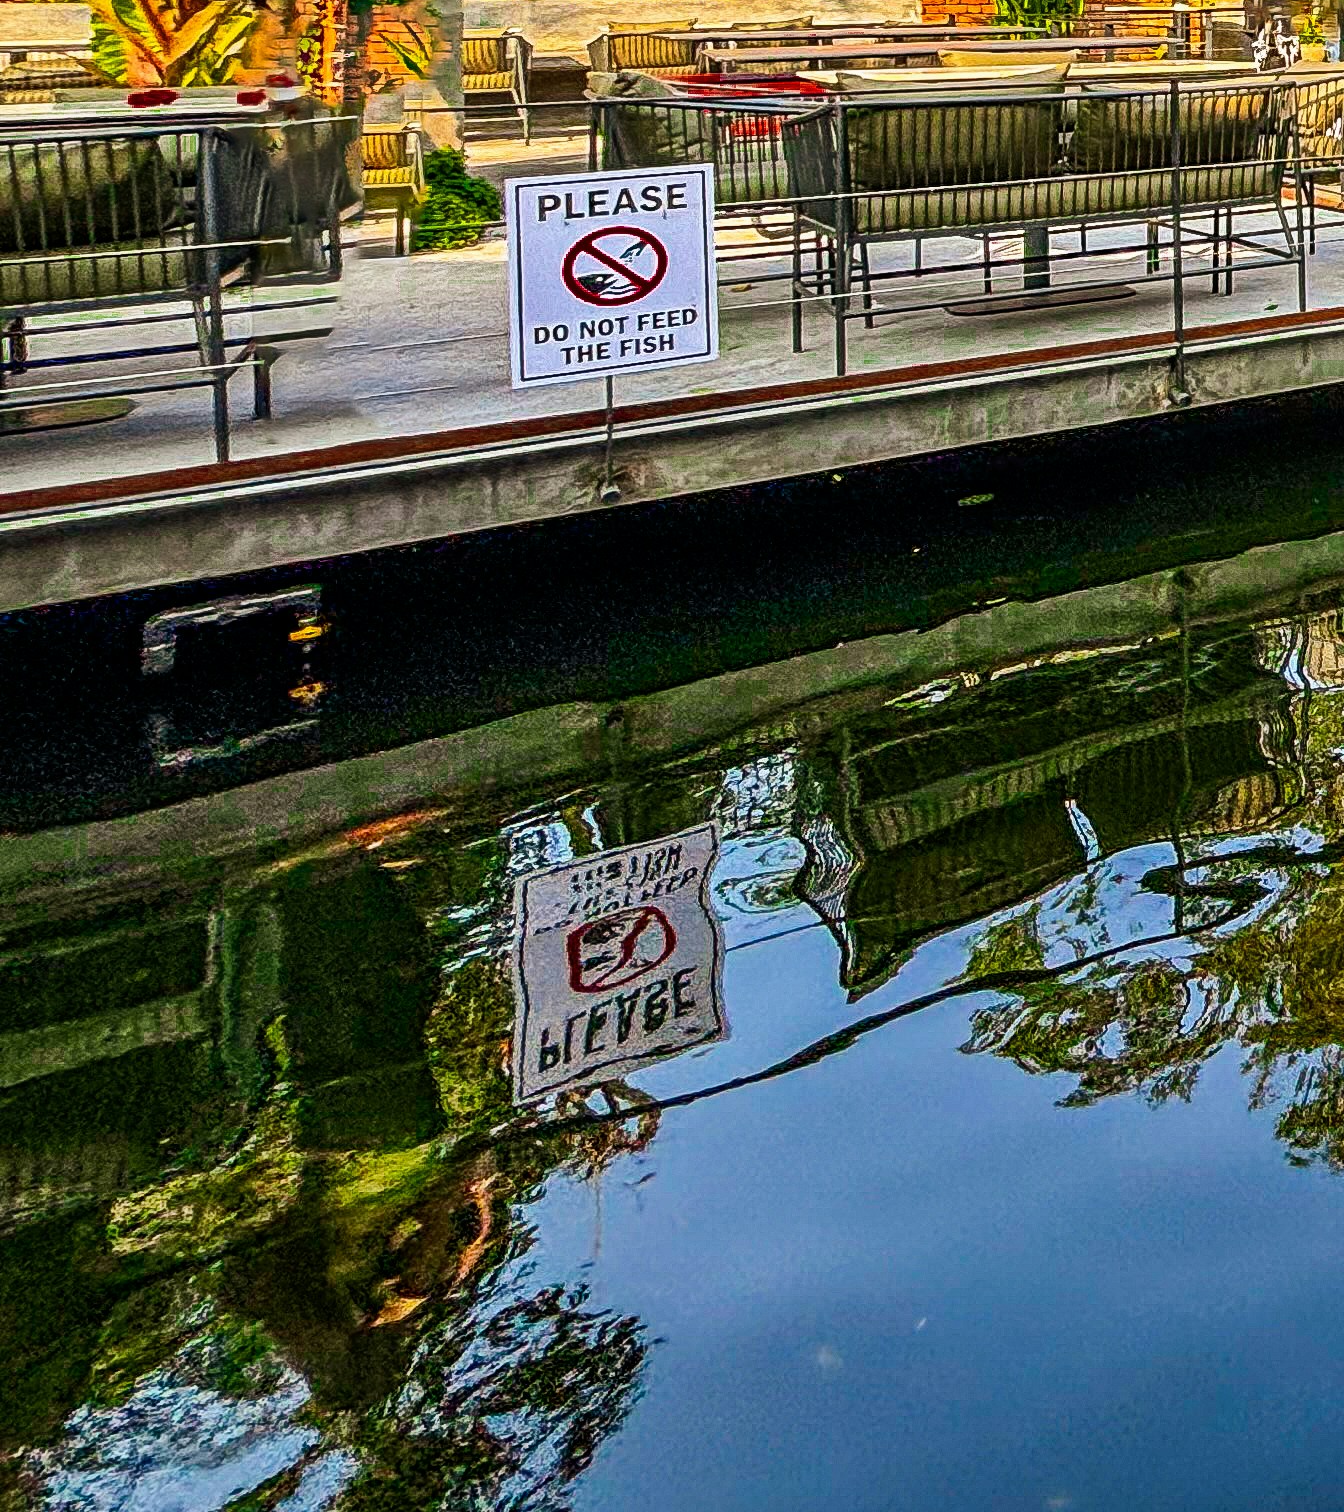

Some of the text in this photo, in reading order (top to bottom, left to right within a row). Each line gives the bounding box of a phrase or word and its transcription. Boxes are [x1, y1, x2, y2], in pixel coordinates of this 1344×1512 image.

[537, 183, 688, 222] PLEASE
[534, 308, 698, 345] DO NOT FEED
[561, 334, 675, 365] THE FISH
